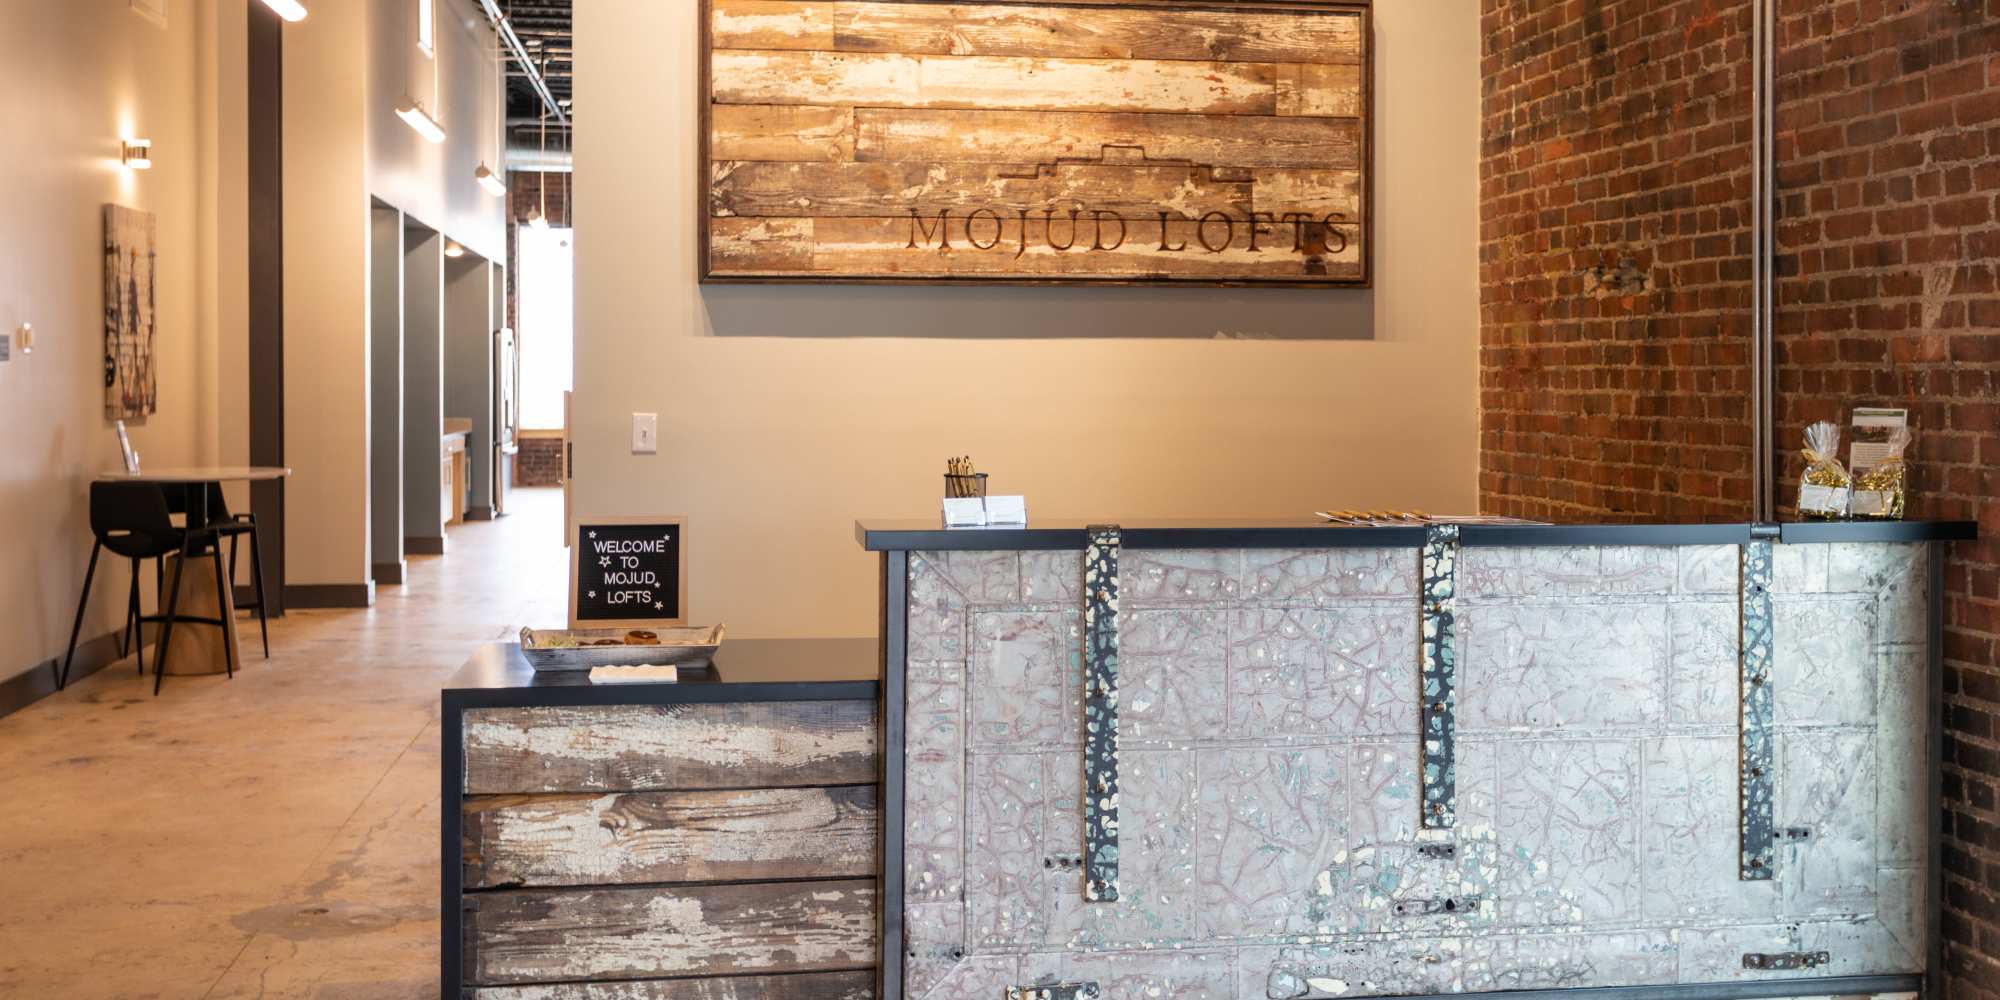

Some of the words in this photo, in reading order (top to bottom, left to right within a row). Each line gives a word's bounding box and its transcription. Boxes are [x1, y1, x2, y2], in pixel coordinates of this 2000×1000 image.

[905, 208, 1127, 260] MOJUD
[1157, 211, 1347, 254] LOFTS
[594, 540, 665, 553] WELCOME
[620, 556, 639, 569] TO
[604, 572, 656, 585] MOJUD
[607, 590, 652, 604] LOFTS
